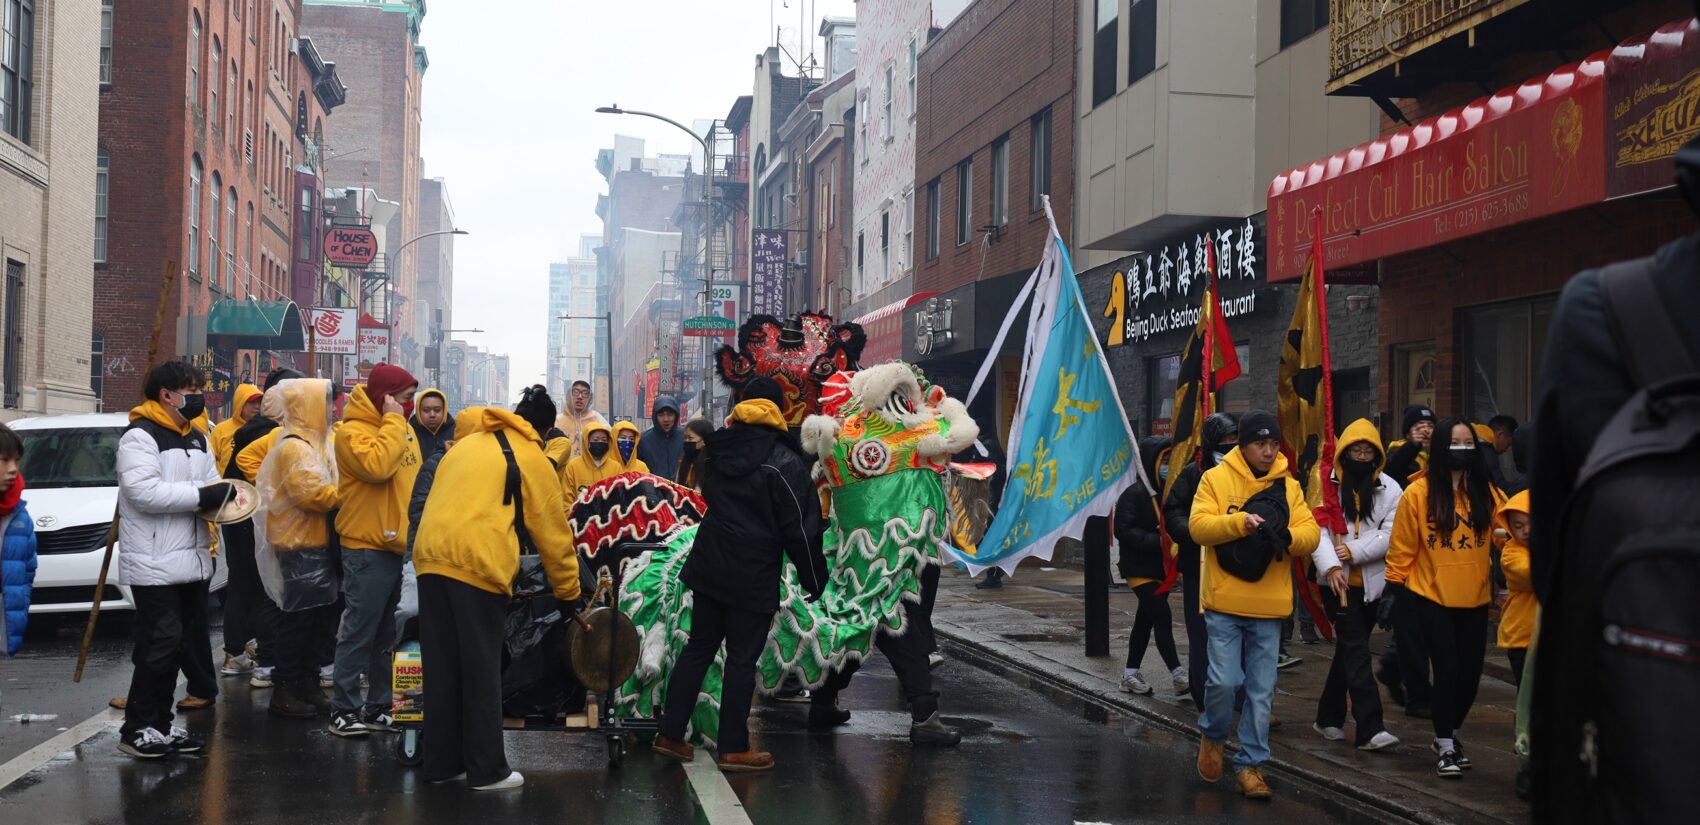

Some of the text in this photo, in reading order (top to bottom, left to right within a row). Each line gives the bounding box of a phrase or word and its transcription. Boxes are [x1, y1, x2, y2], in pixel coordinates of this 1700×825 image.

[1294, 128, 1529, 243] Pefect Cut Hair Salon
[1454, 208, 1478, 231] (215)
[1481, 191, 1529, 221] 625-3688
[712, 288, 732, 299] 929
[773, 262, 784, 316] RESTAURANT
[684, 321, 727, 329] HUTCHINSON
[1126, 315, 1149, 343] Beijing
[1150, 308, 1169, 334] Duck
[1061, 476, 1098, 512] THE
